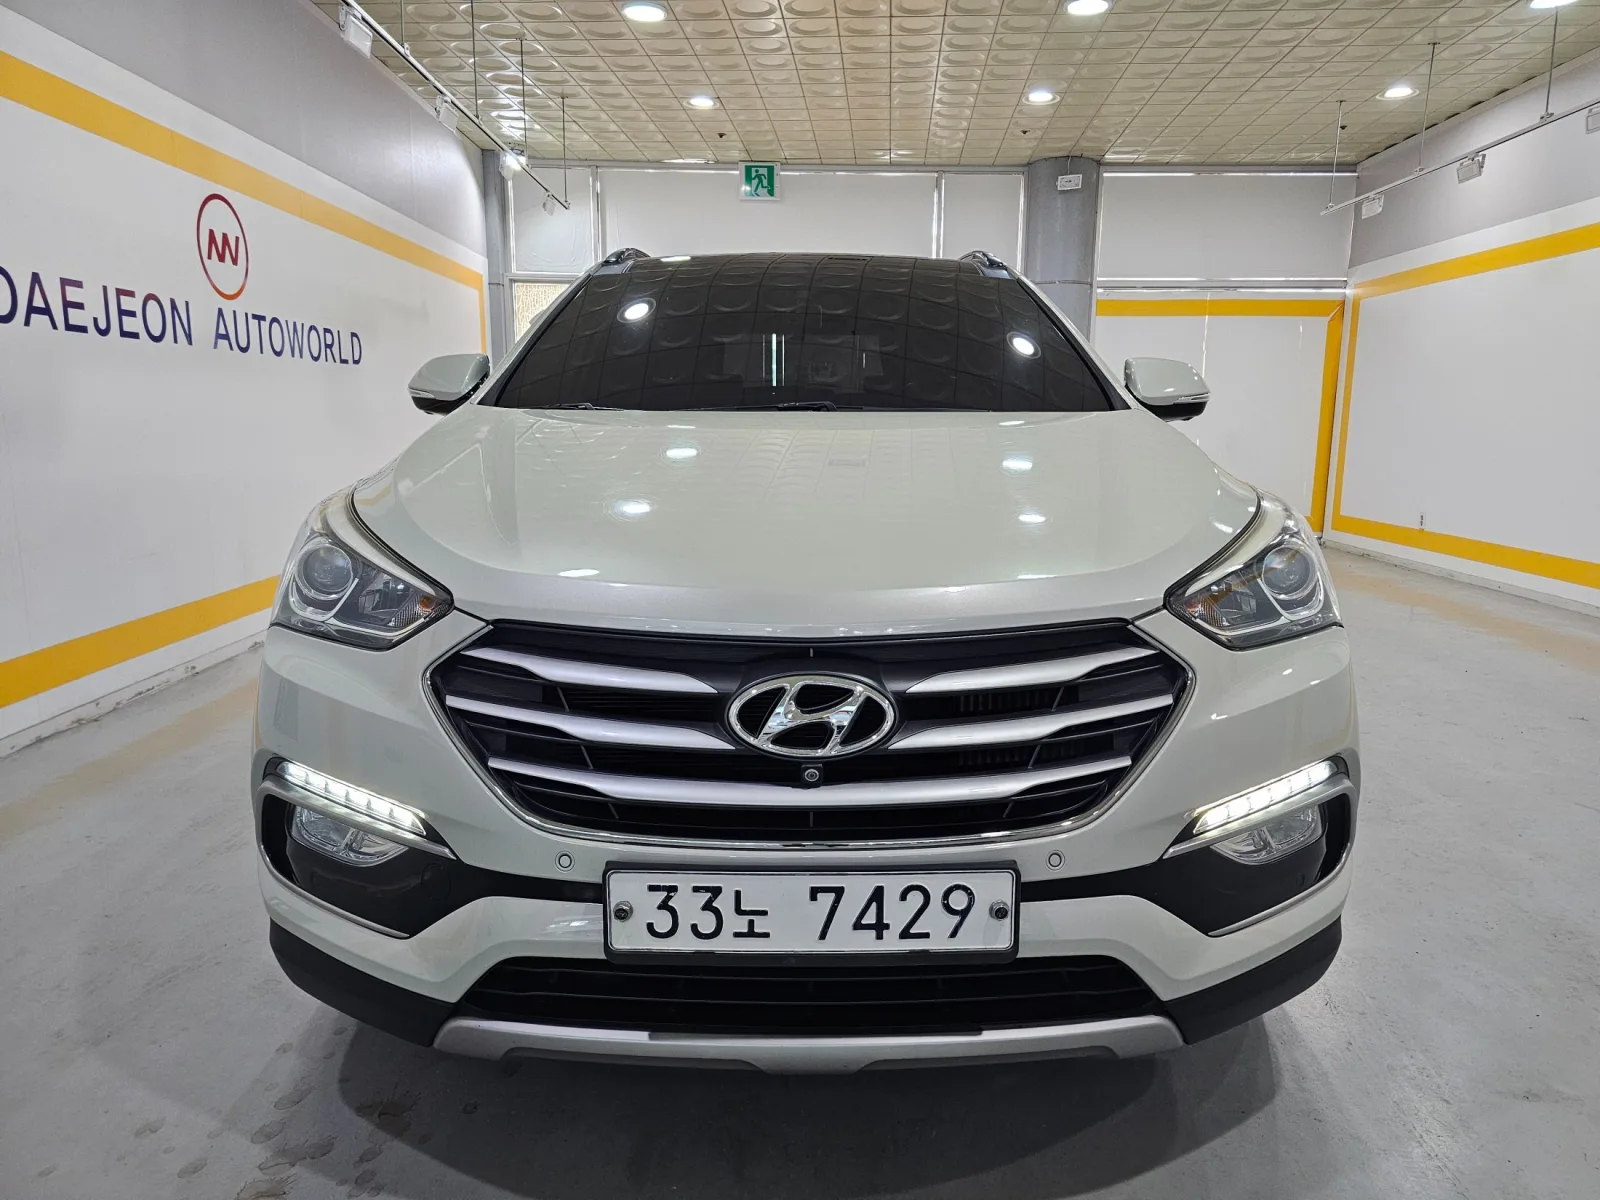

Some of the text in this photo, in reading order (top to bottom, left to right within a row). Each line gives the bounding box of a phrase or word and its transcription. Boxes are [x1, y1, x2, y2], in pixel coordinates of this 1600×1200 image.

[0, 265, 363, 365] DAEJEON AUTOWORLD
[646, 883, 976, 941] 33노 7429
